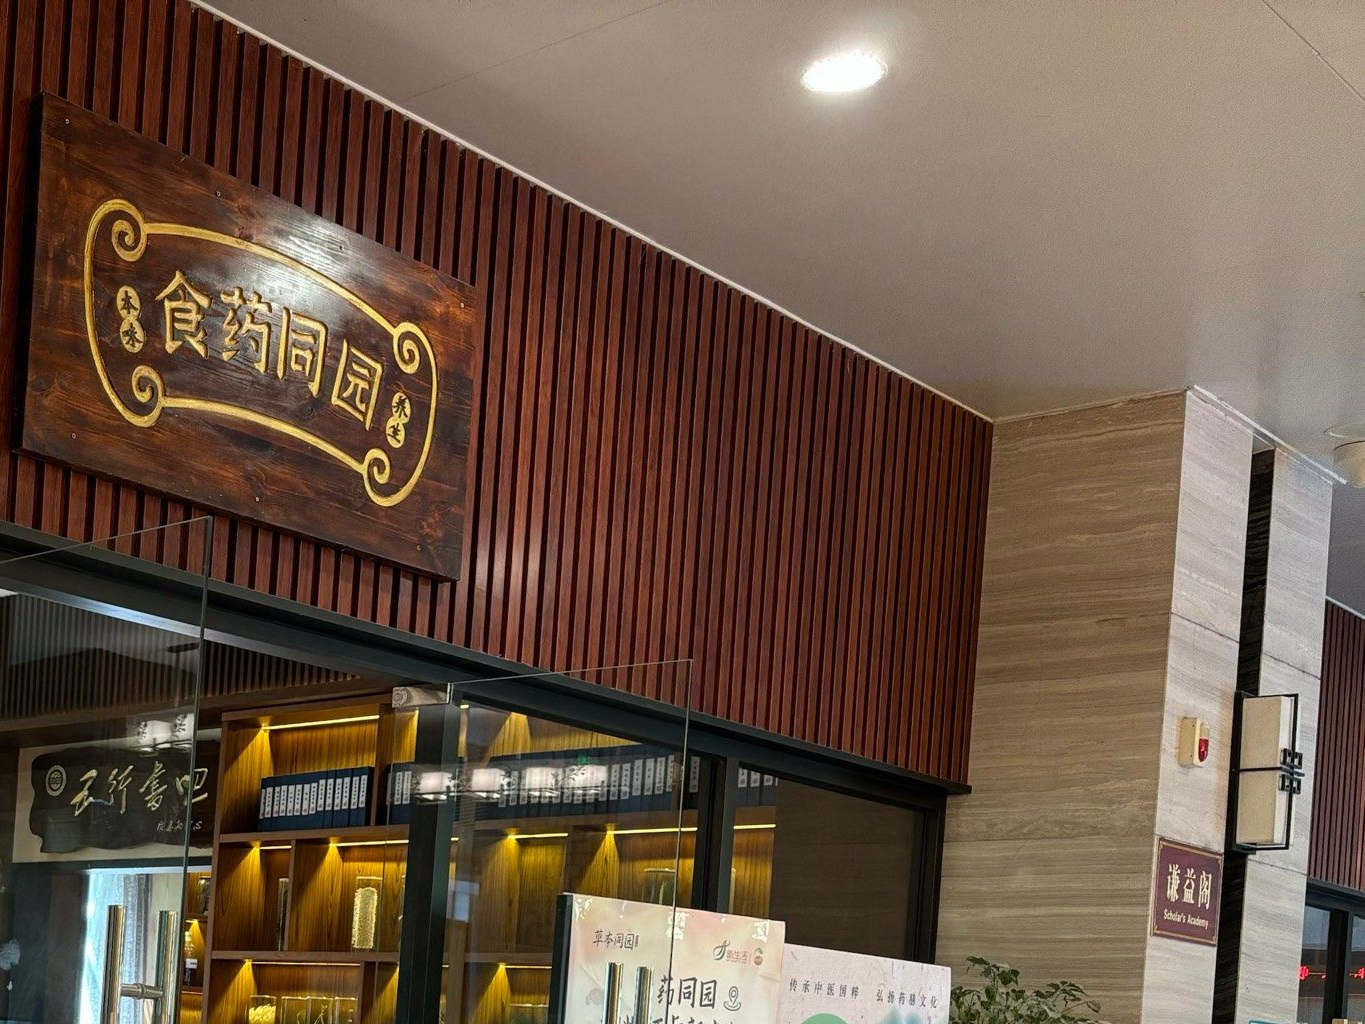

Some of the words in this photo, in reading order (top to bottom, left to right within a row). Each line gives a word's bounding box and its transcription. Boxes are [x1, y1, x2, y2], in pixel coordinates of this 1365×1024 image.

[155, 270, 383, 431] 食药同园
[1165, 863, 1212, 910] 谦益阁
[1163, 908, 1186, 923] Scholar's
[1186, 913, 1209, 930] Academy
[592, 930, 635, 950] 草本同园
[789, 978, 859, 998] 传承中医国粹
[876, 989, 938, 1009] 弘扬药膳文化
